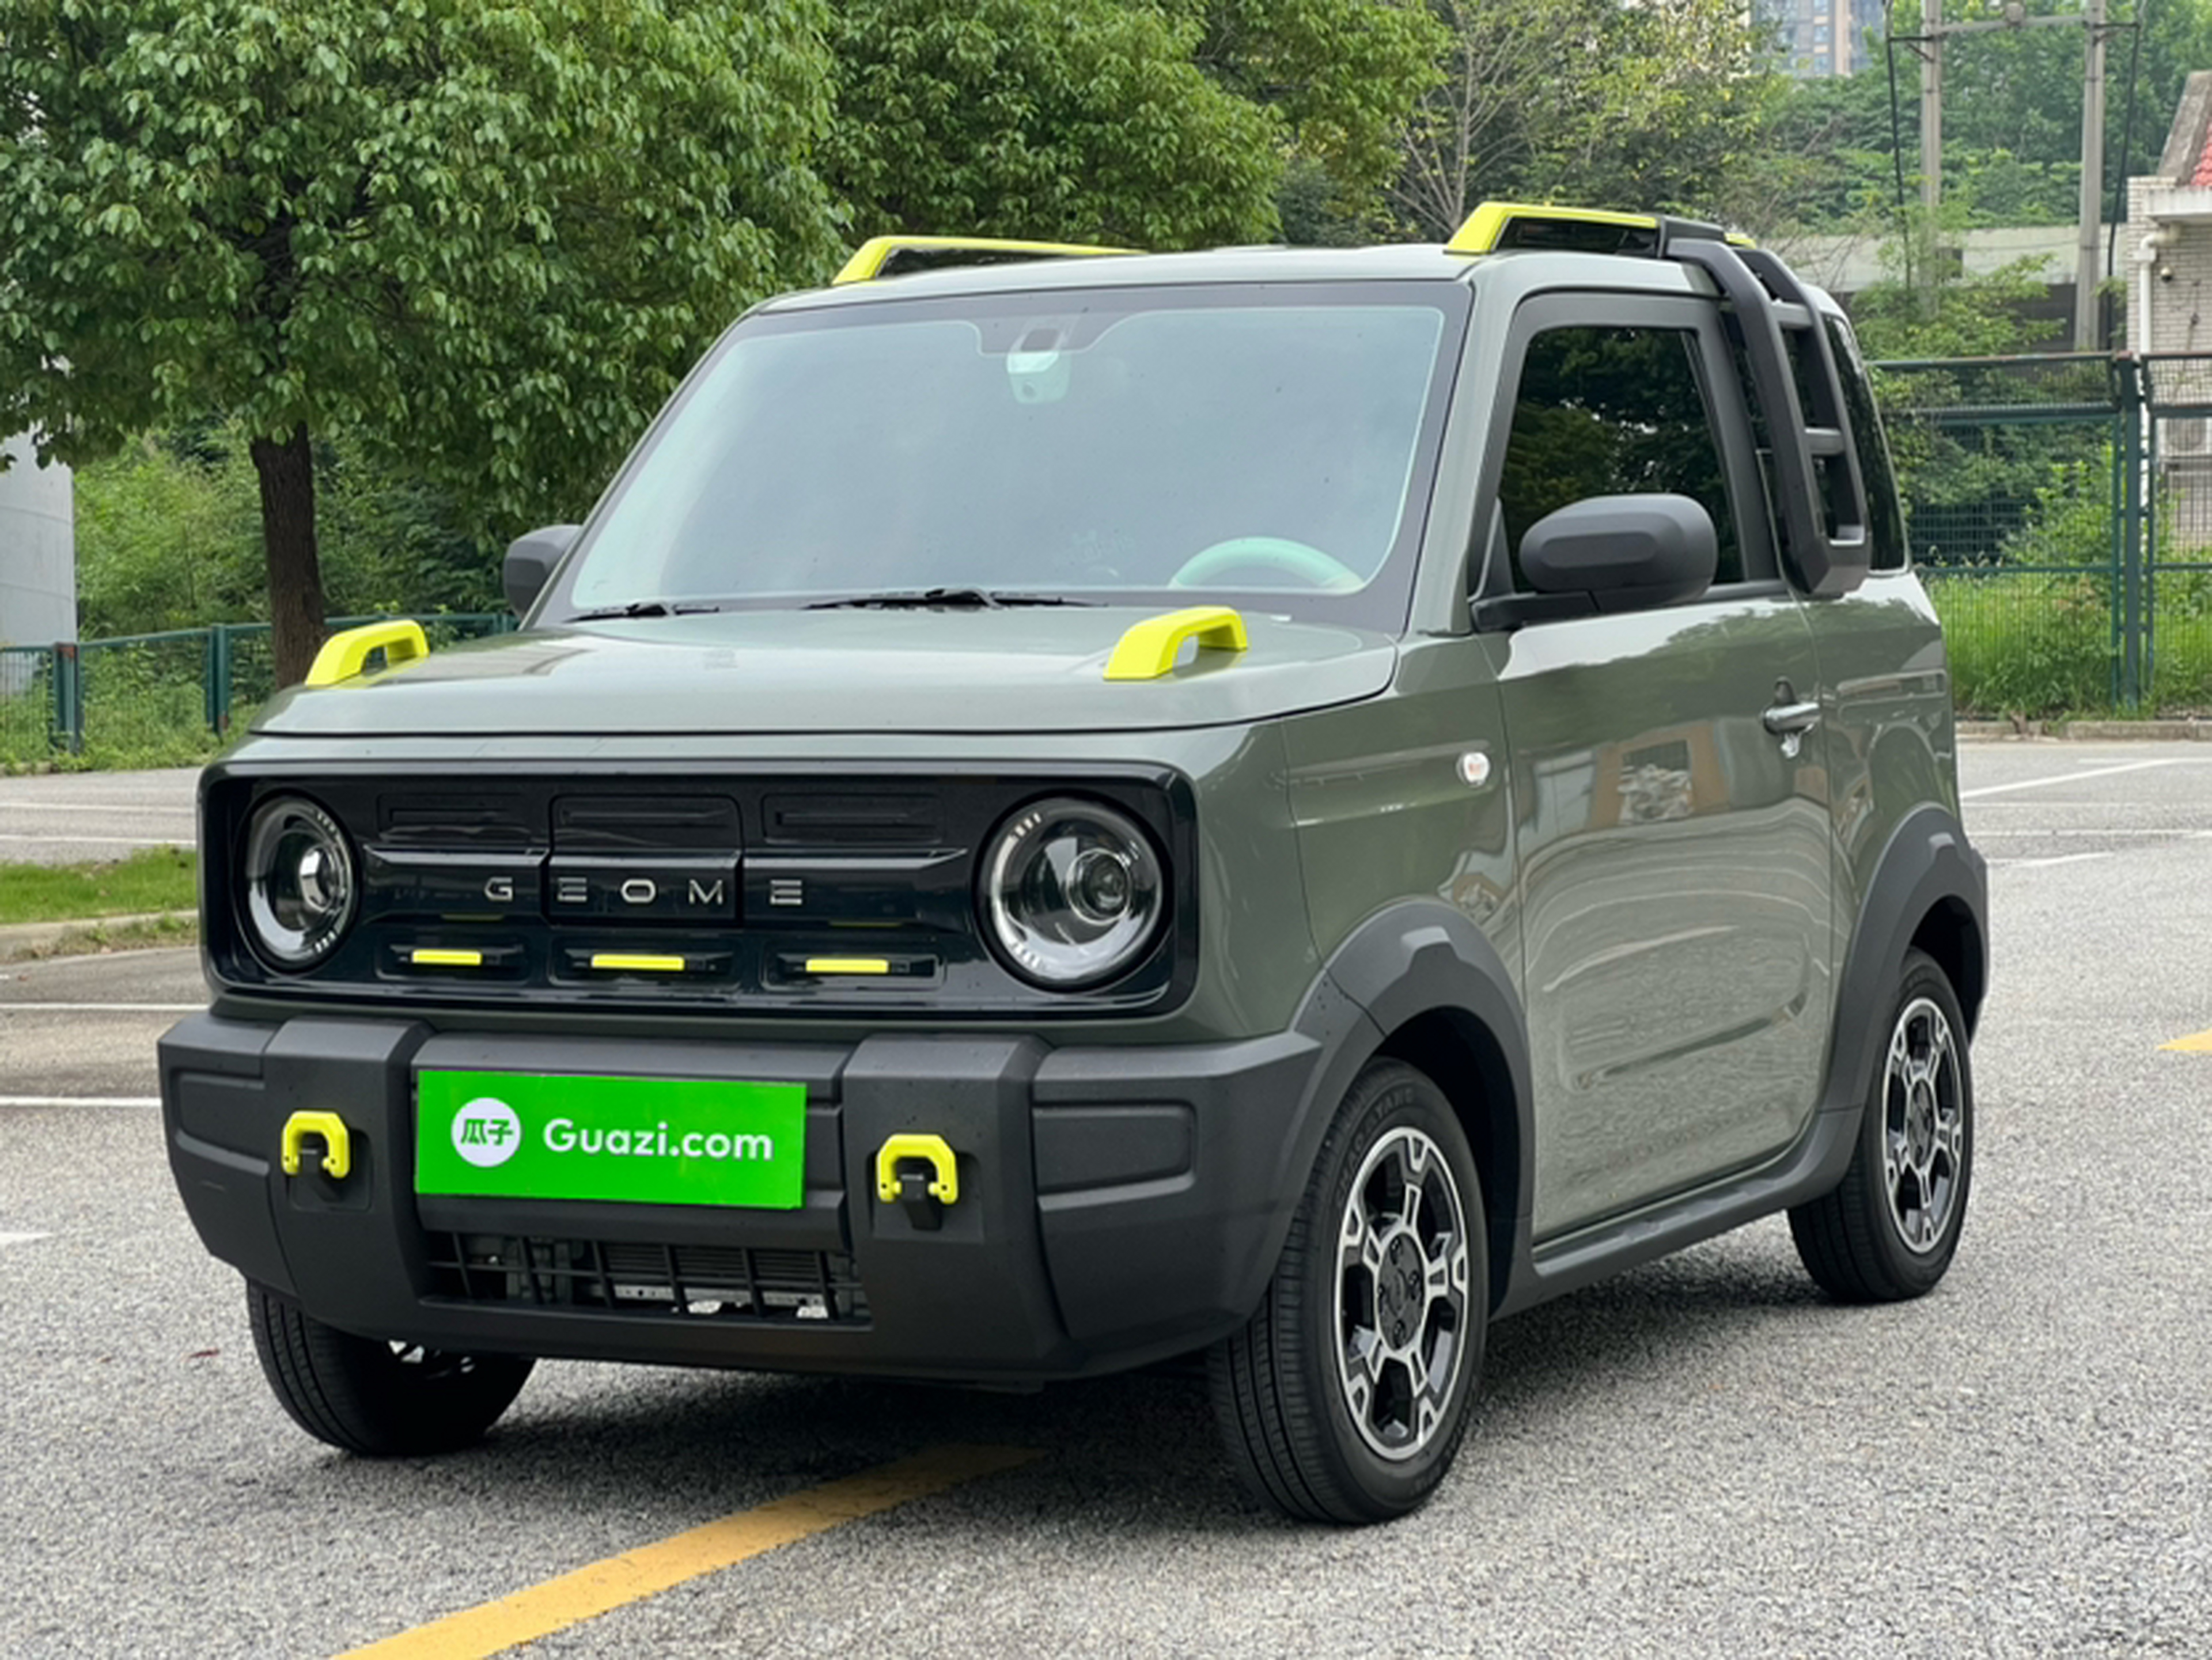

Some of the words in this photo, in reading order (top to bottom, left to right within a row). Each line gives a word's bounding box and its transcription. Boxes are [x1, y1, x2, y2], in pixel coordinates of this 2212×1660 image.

[484, 877, 802, 905] GEOME
[460, 1119, 513, 1145] 瓜子
[543, 1119, 773, 1160] Guazi.com
